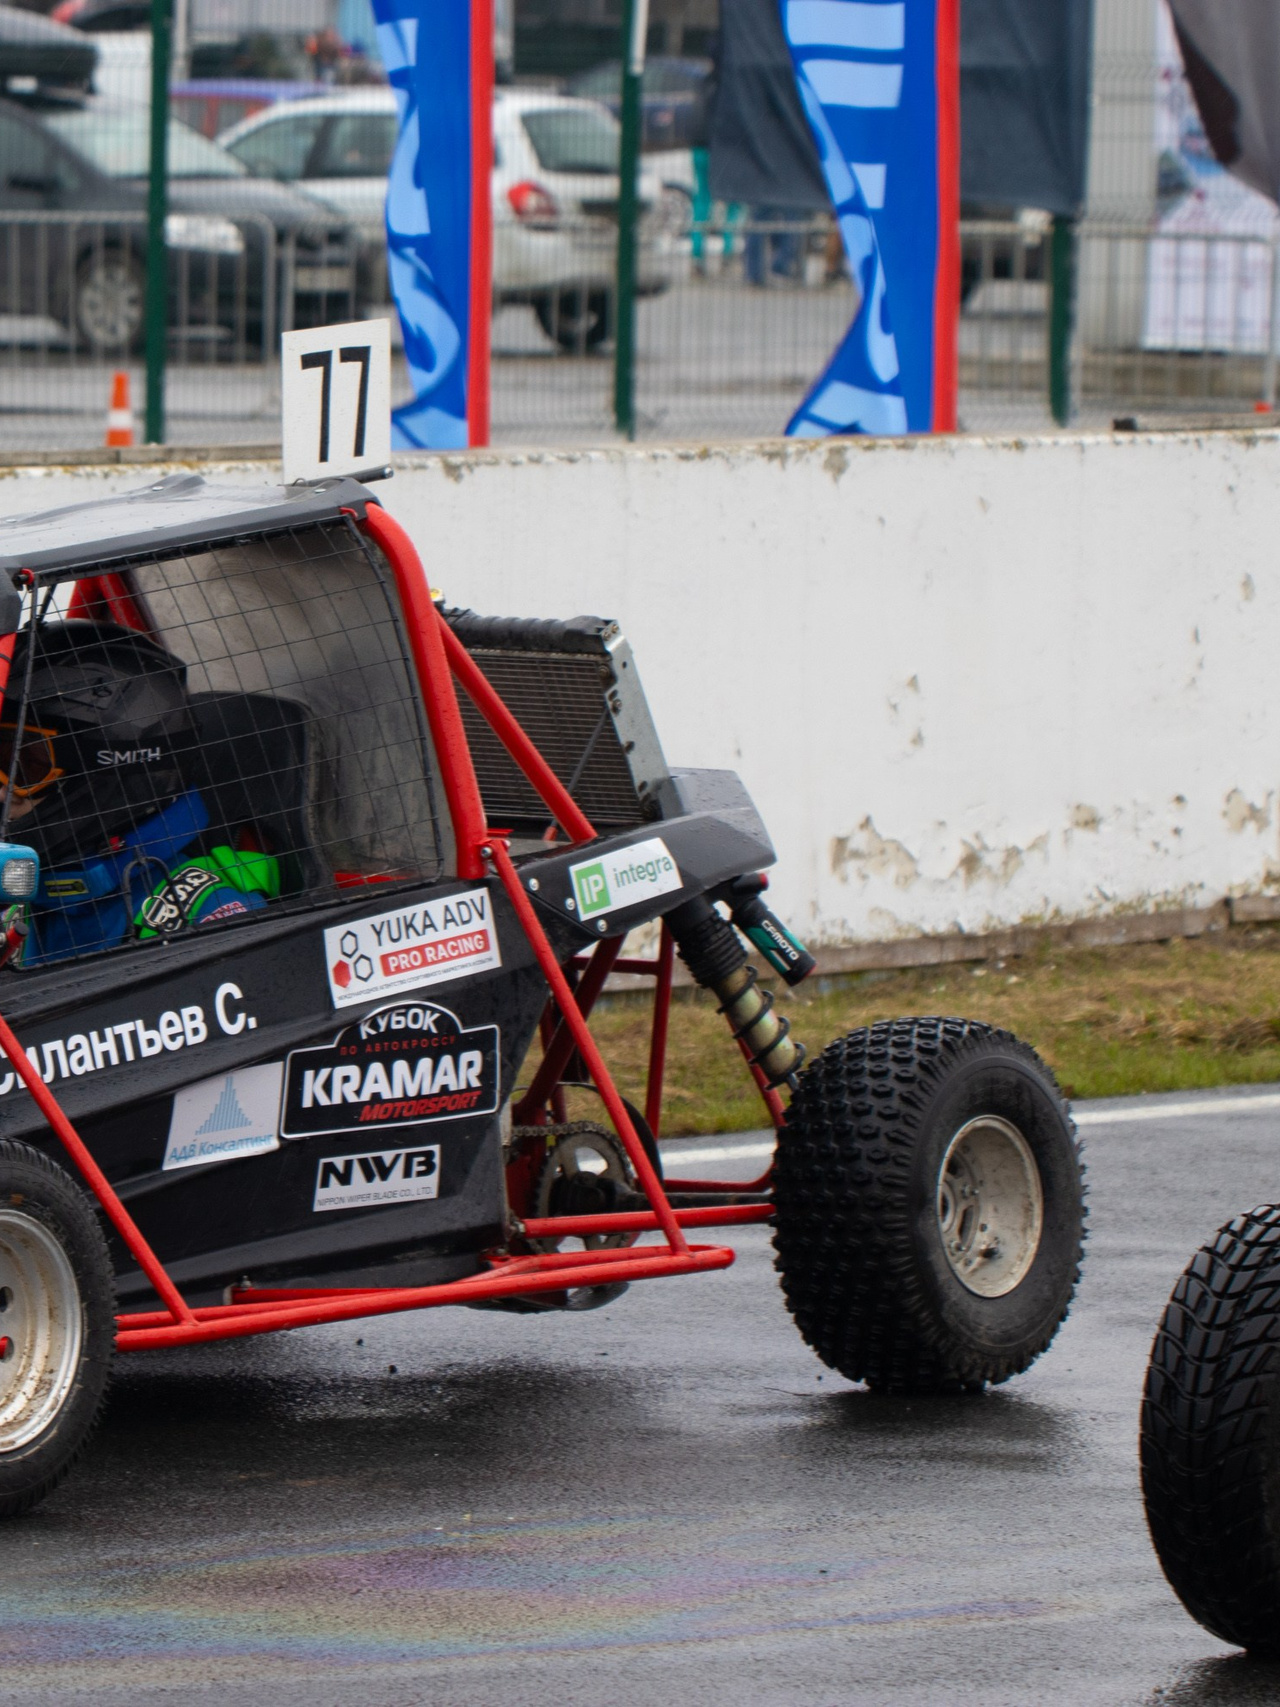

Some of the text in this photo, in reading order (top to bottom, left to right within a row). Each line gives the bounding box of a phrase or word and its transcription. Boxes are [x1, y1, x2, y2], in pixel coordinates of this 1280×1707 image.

[300, 345, 372, 463] 77
[97, 747, 161, 765] SMITH
[613, 856, 673, 888] integra
[581, 874, 604, 905] IP
[370, 895, 486, 946] YUKA ADV
[388, 934, 485, 972] PRO RACING
[761, 920, 799, 960] CFMOTO
[215, 982, 257, 1035] С.
[360, 1008, 441, 1040] КУБОК
[340, 1035, 456, 1055] ПО АВТОКРОССУ
[302, 1050, 483, 1108] KRAMAR
[359, 1090, 482, 1122] MOTORSPORT
[169, 1134, 273, 1162] АДВ Консалтинг
[319, 1150, 437, 1189] NWB
[317, 1196, 345, 1207] NIPPON
[346, 1193, 372, 1204] WIPER
[373, 1190, 397, 1200] BLADE
